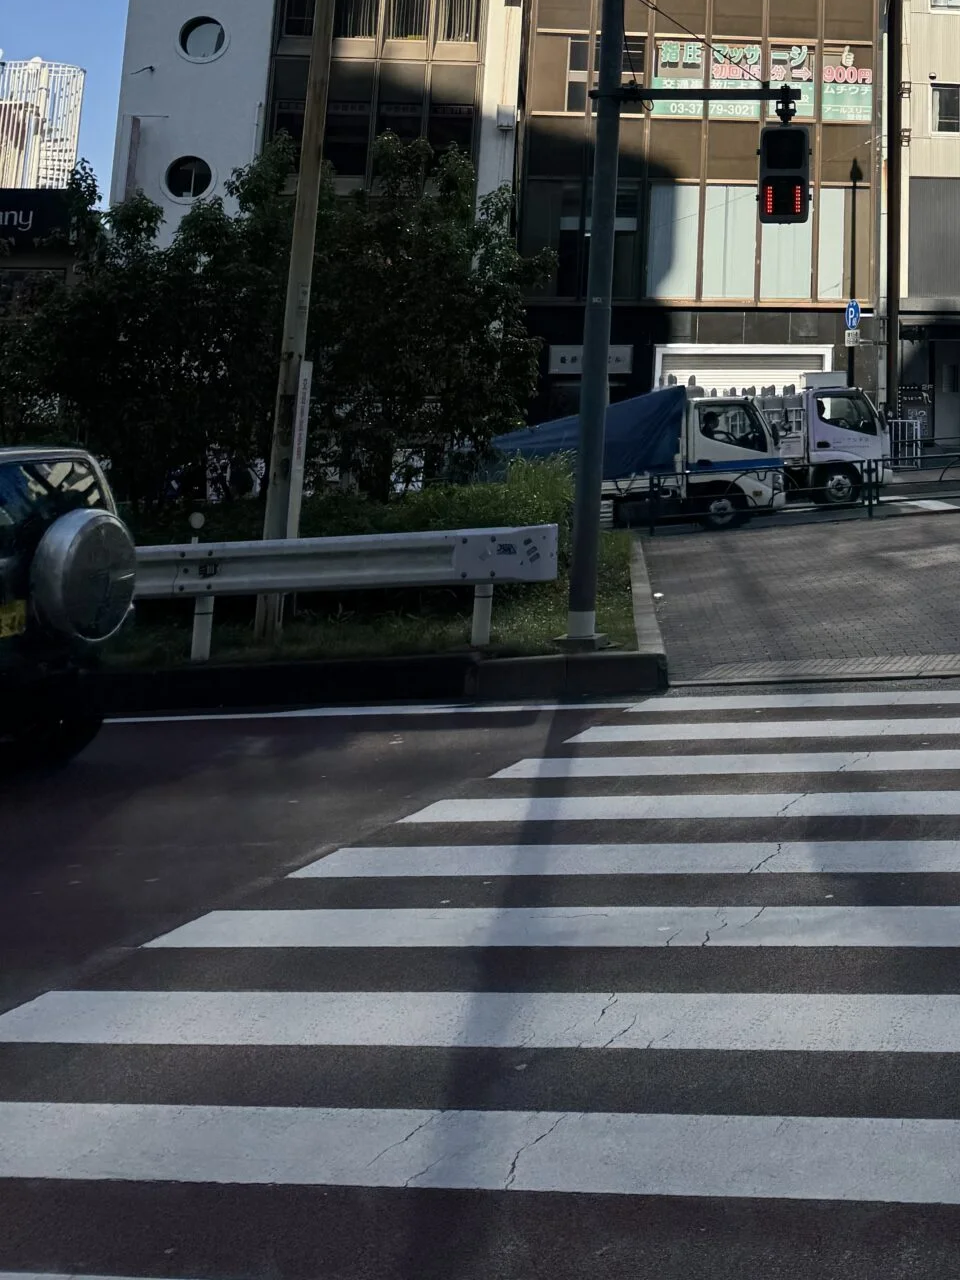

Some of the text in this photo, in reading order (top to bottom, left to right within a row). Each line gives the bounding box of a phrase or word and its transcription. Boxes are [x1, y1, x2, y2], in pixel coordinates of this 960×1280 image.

[661, 41, 809, 66] 指圧マッサージ
[823, 65, 872, 84] 900円
[669, 102, 755, 116] 03-3779-3021
[0, 210, 34, 231] ny
